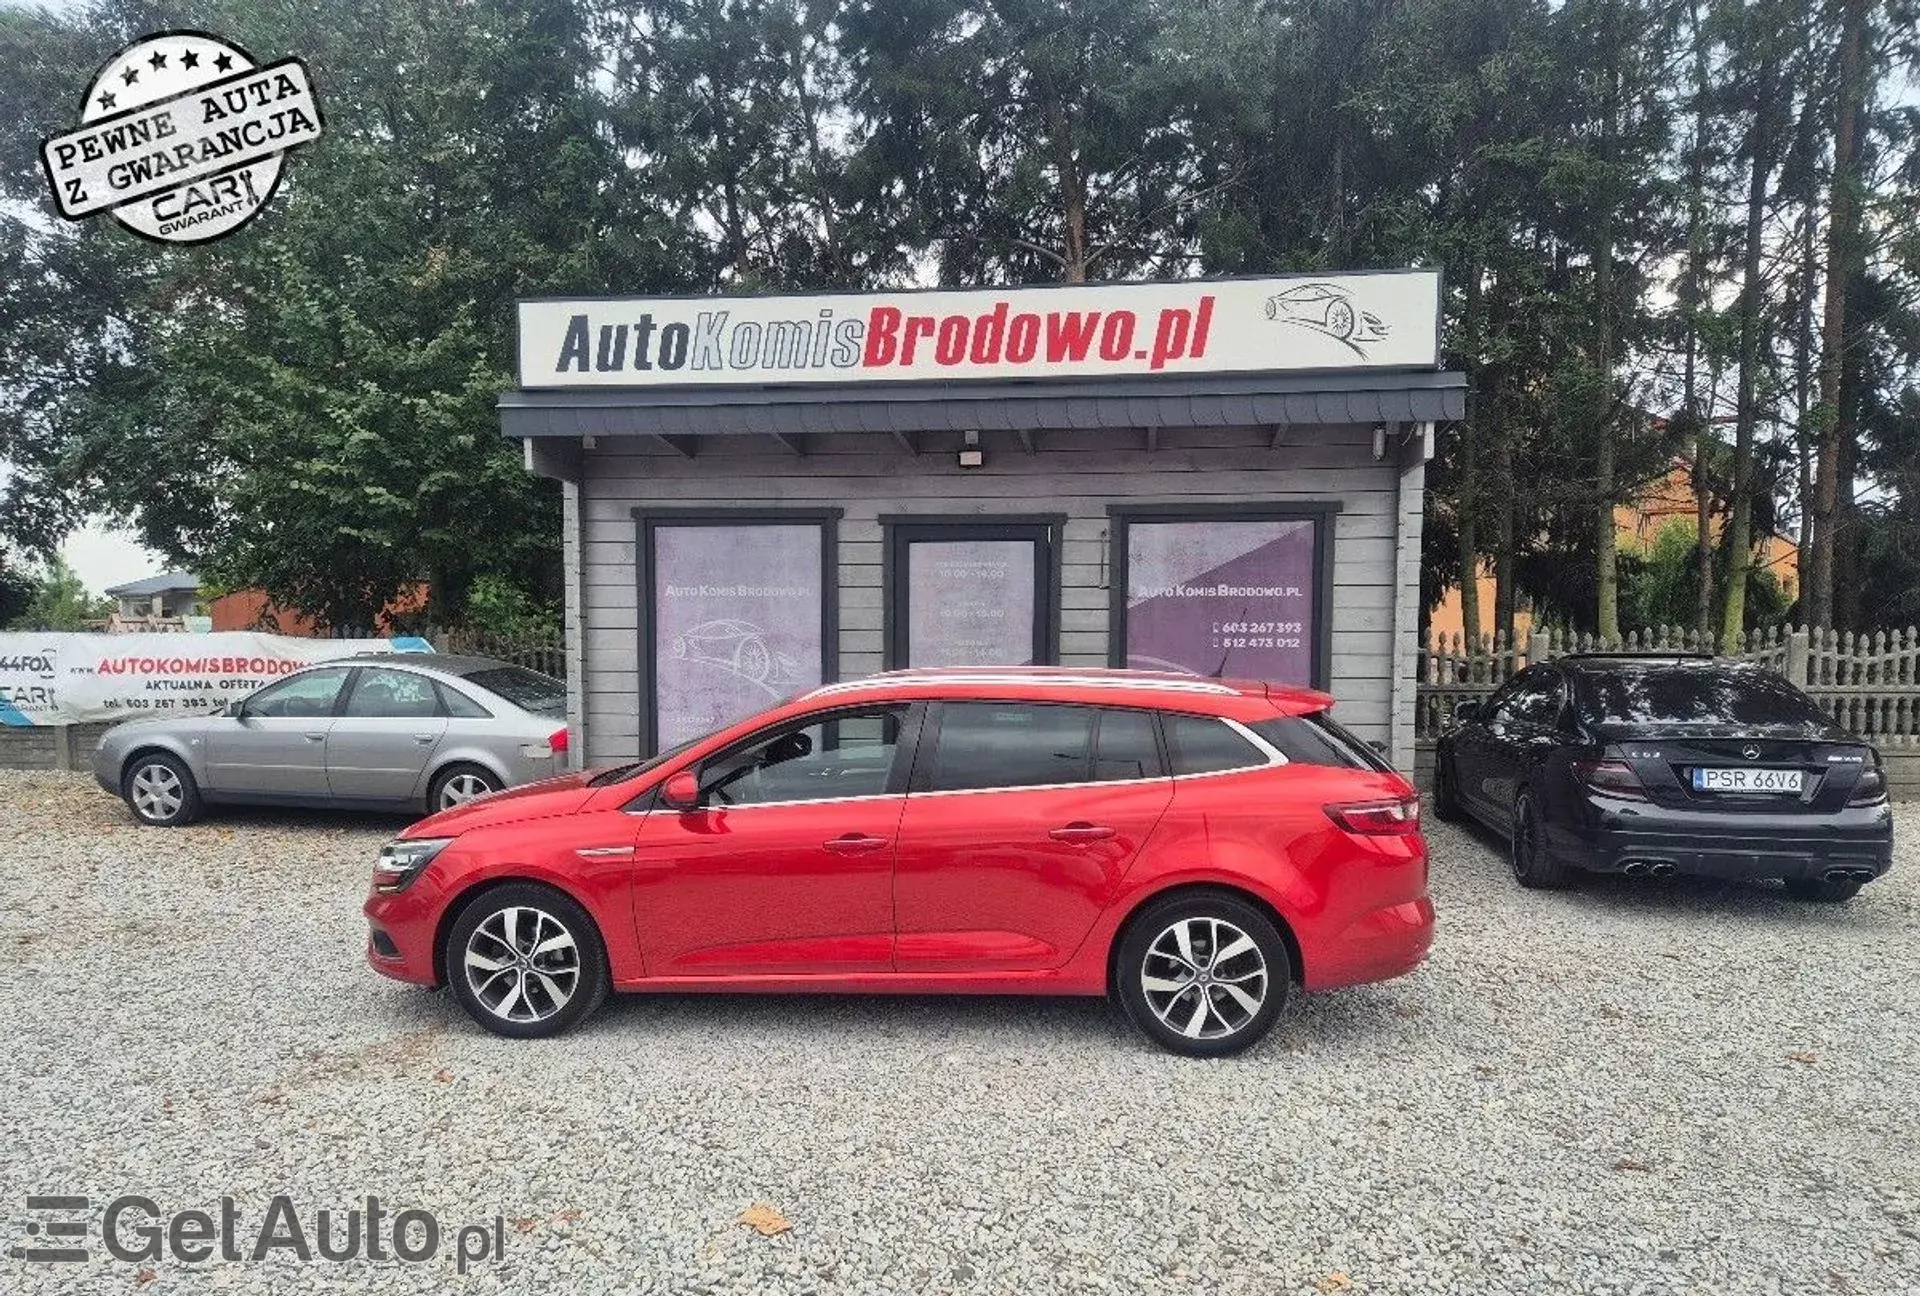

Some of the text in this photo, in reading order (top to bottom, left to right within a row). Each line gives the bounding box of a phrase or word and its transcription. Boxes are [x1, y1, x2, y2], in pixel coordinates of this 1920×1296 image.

[555, 296, 1216, 373] AutoKomisBrodowo.pl
[1222, 622, 1302, 633] 603 267 393
[1223, 638, 1300, 648] 512 473 012
[146, 679, 214, 690] AKTUALNA
[127, 698, 149, 709] 603
[155, 698, 175, 709] 267
[1706, 770, 1746, 787] PSR
[1753, 771, 1799, 789] 66V6
